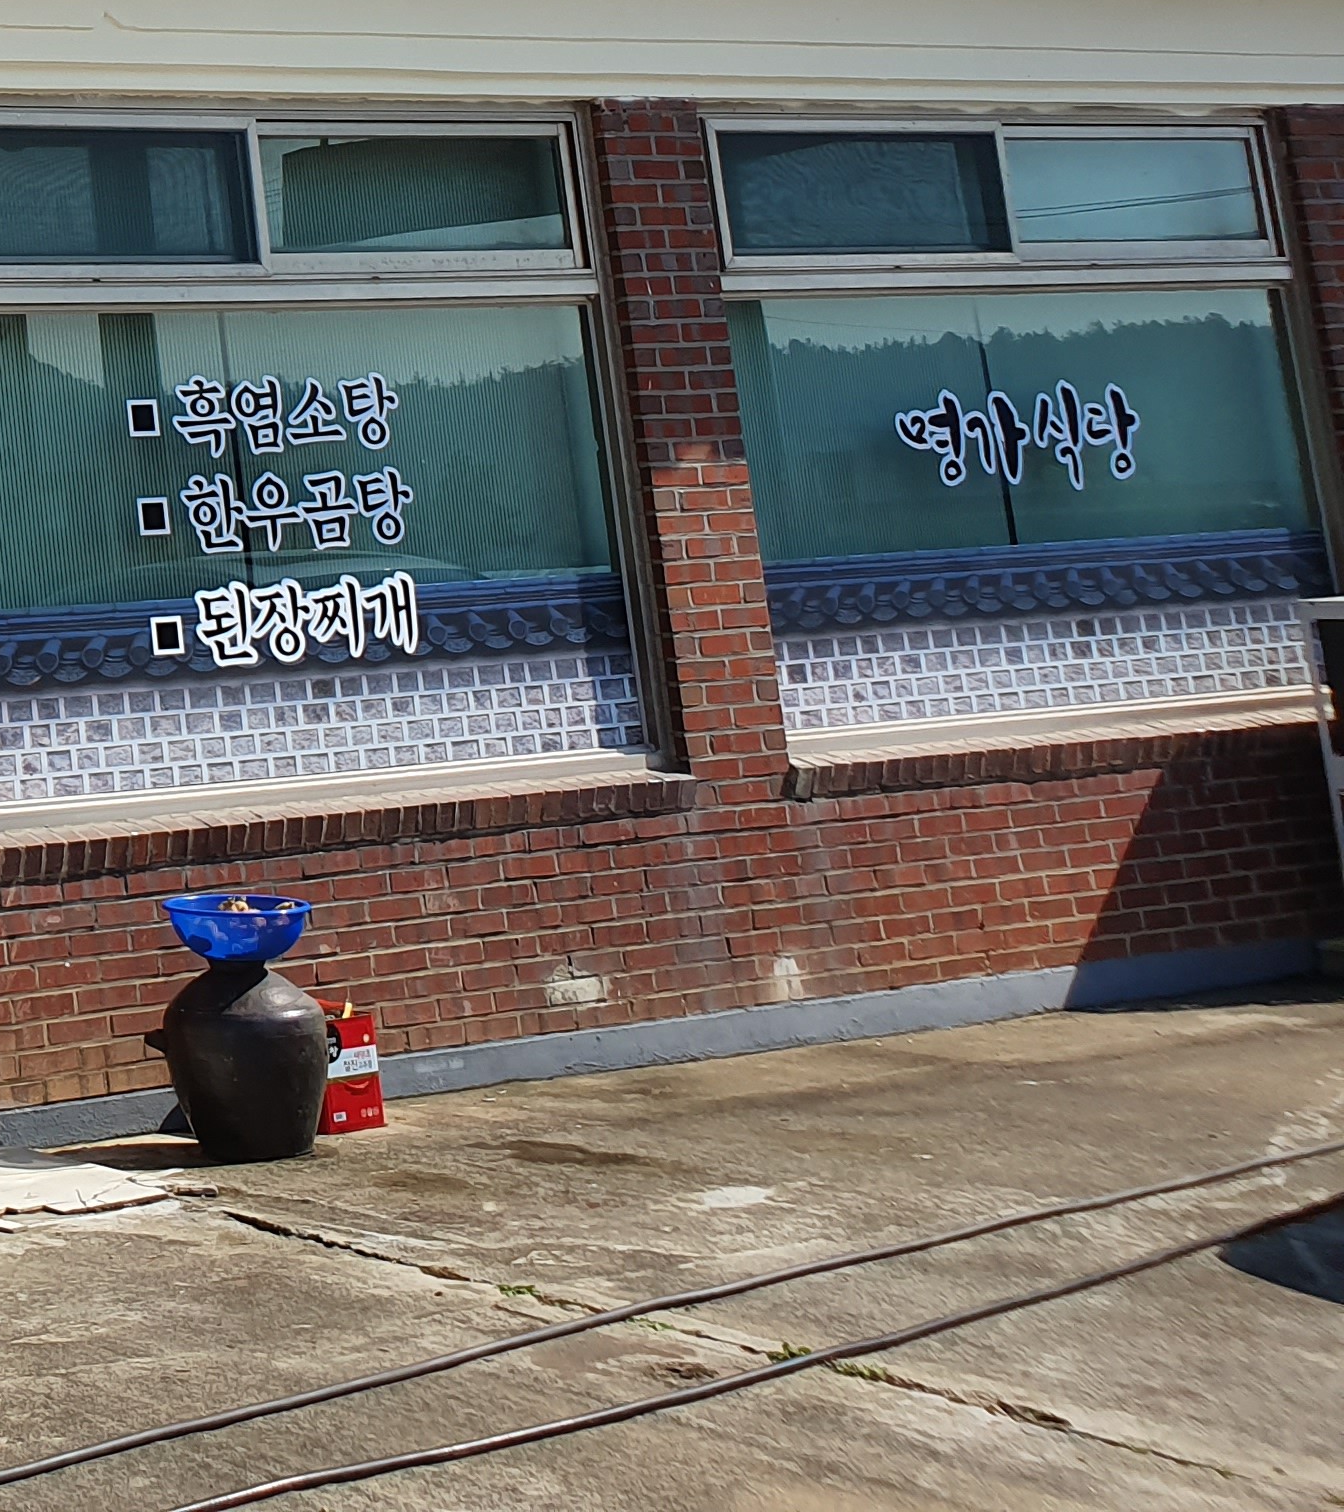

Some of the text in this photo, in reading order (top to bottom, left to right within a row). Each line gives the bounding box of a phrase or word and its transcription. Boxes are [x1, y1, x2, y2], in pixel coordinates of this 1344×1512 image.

[172, 371, 399, 458] 흑염소탕
[895, 379, 1140, 491] 명가식당
[180, 465, 413, 554] 한우곰탕
[195, 570, 419, 667] 된장찌개
